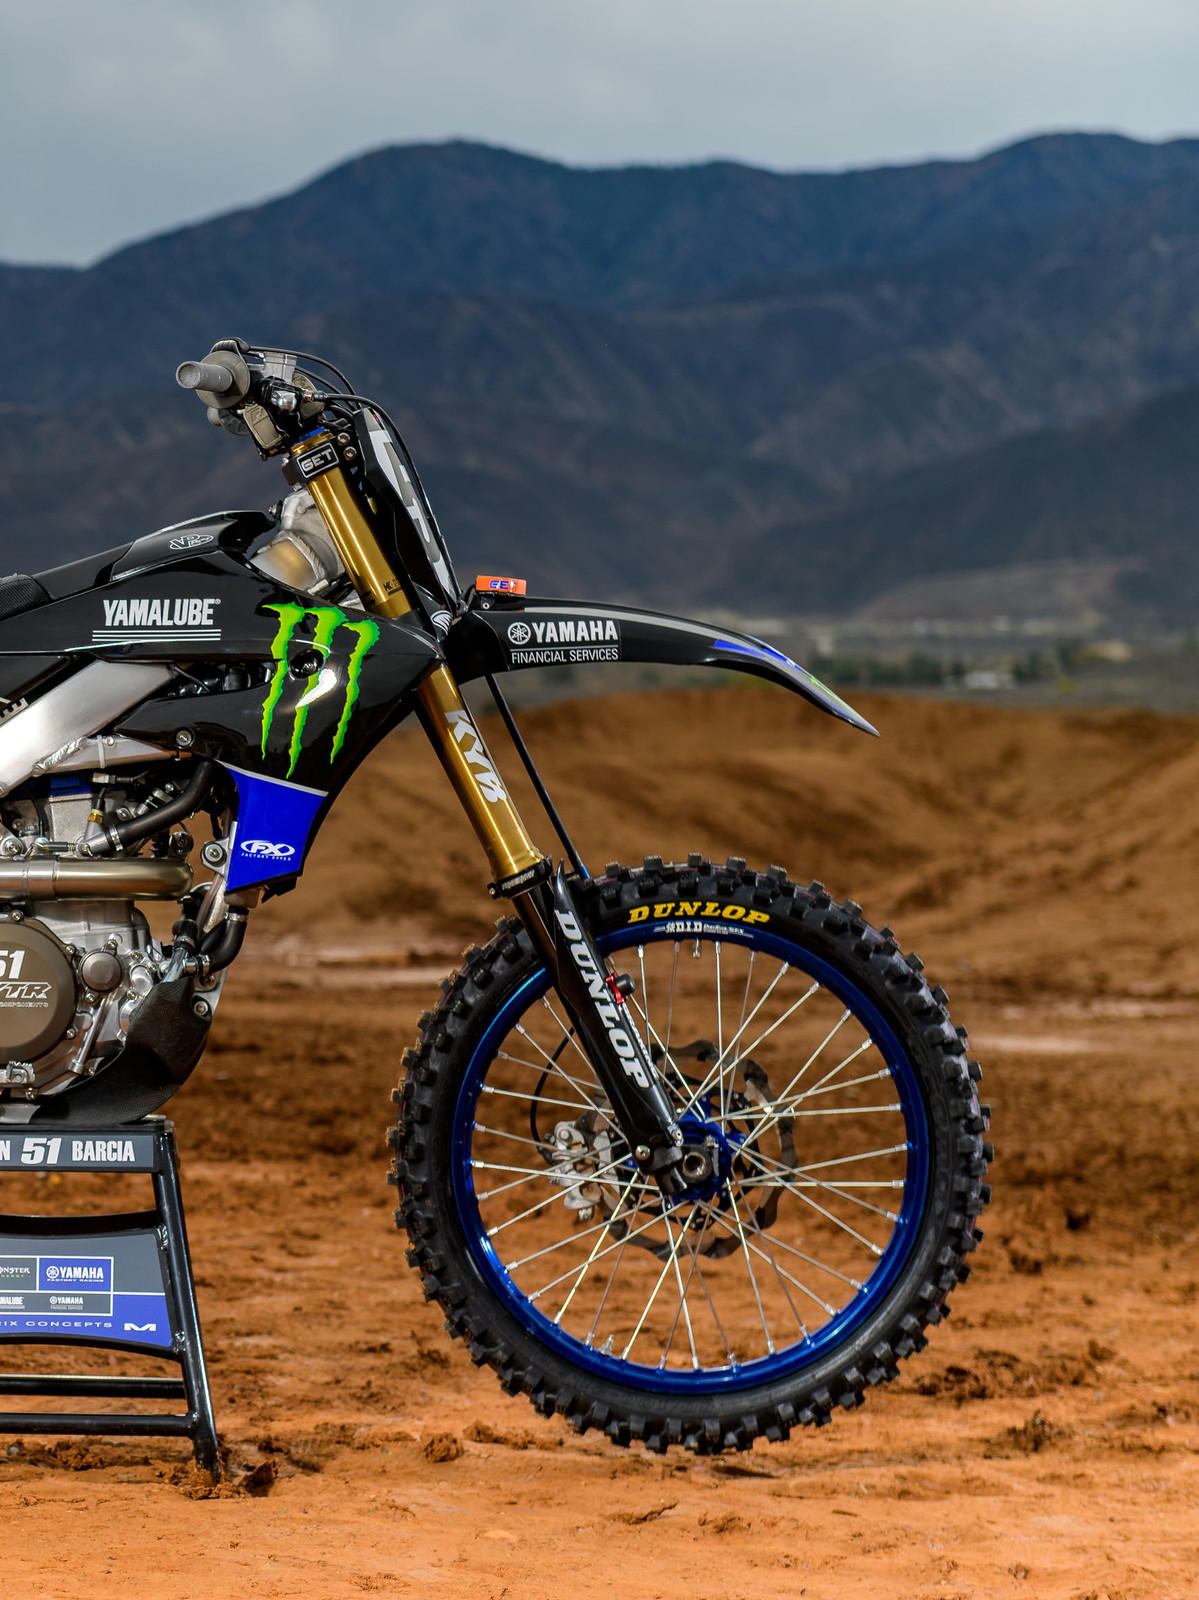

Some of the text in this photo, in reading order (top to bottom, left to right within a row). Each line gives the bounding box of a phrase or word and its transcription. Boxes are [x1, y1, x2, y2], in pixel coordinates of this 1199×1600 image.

[301, 448, 332, 472] GET
[103, 598, 216, 626] YAMALUBE
[531, 620, 618, 643] YAMAHA
[511, 648, 619, 664] FINANCIAL SERVICES
[444, 709, 507, 803] KYB
[627, 901, 770, 924] DUNLOP
[554, 909, 650, 1088] DUNLOP
[20, 1137, 62, 1165] 51
[72, 1140, 136, 1162] BARCIA
[59, 1266, 104, 1279] YAMAHA
[57, 1296, 84, 1305] YAMAHA
[25, 1320, 113, 1328] CONCEPTS
